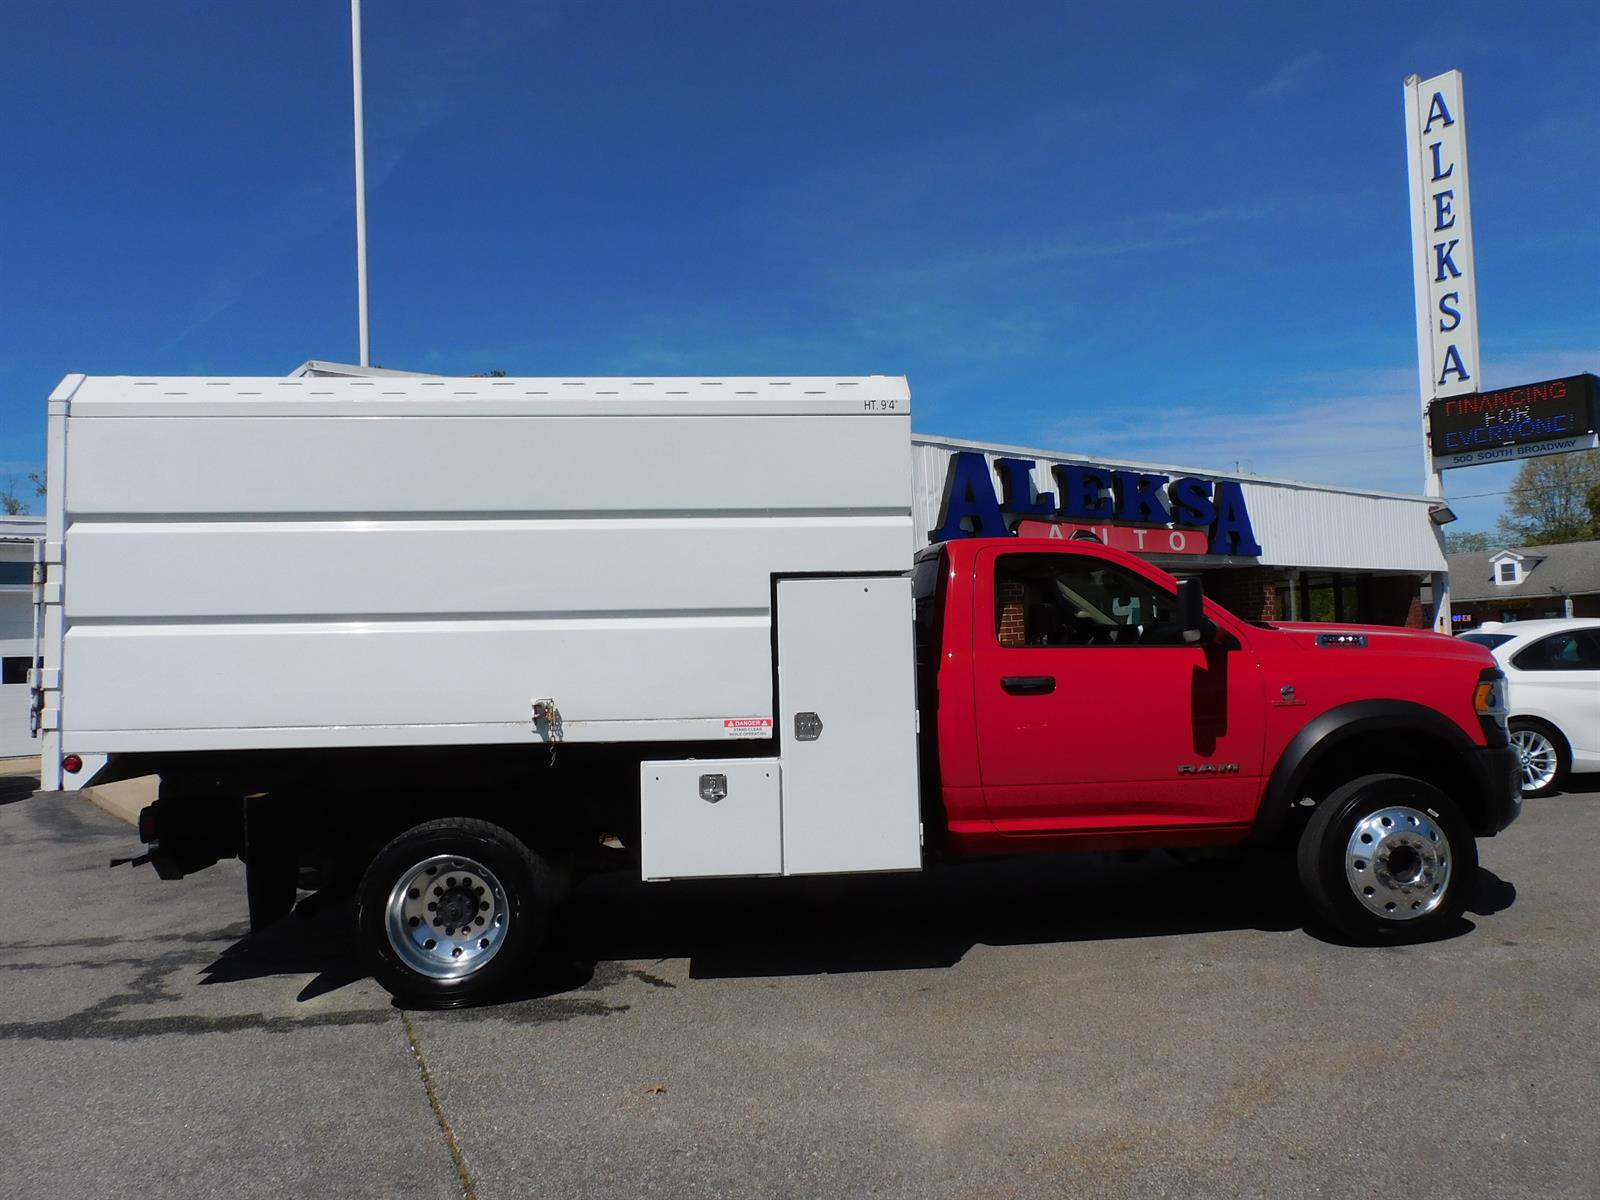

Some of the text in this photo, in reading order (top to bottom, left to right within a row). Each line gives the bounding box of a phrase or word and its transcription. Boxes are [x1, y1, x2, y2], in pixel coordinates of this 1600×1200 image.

[1423, 91, 1470, 385] ALEKSA
[864, 399, 879, 410] HT.
[1444, 381, 1567, 416] FINANCING
[1444, 413, 1575, 448] EVERYONE!
[1485, 405, 1531, 427] FOR
[1453, 439, 1577, 464] 500 SOUTH BROADWAY
[930, 451, 1262, 557] ALEKSA
[1177, 763, 1239, 775] RAM
